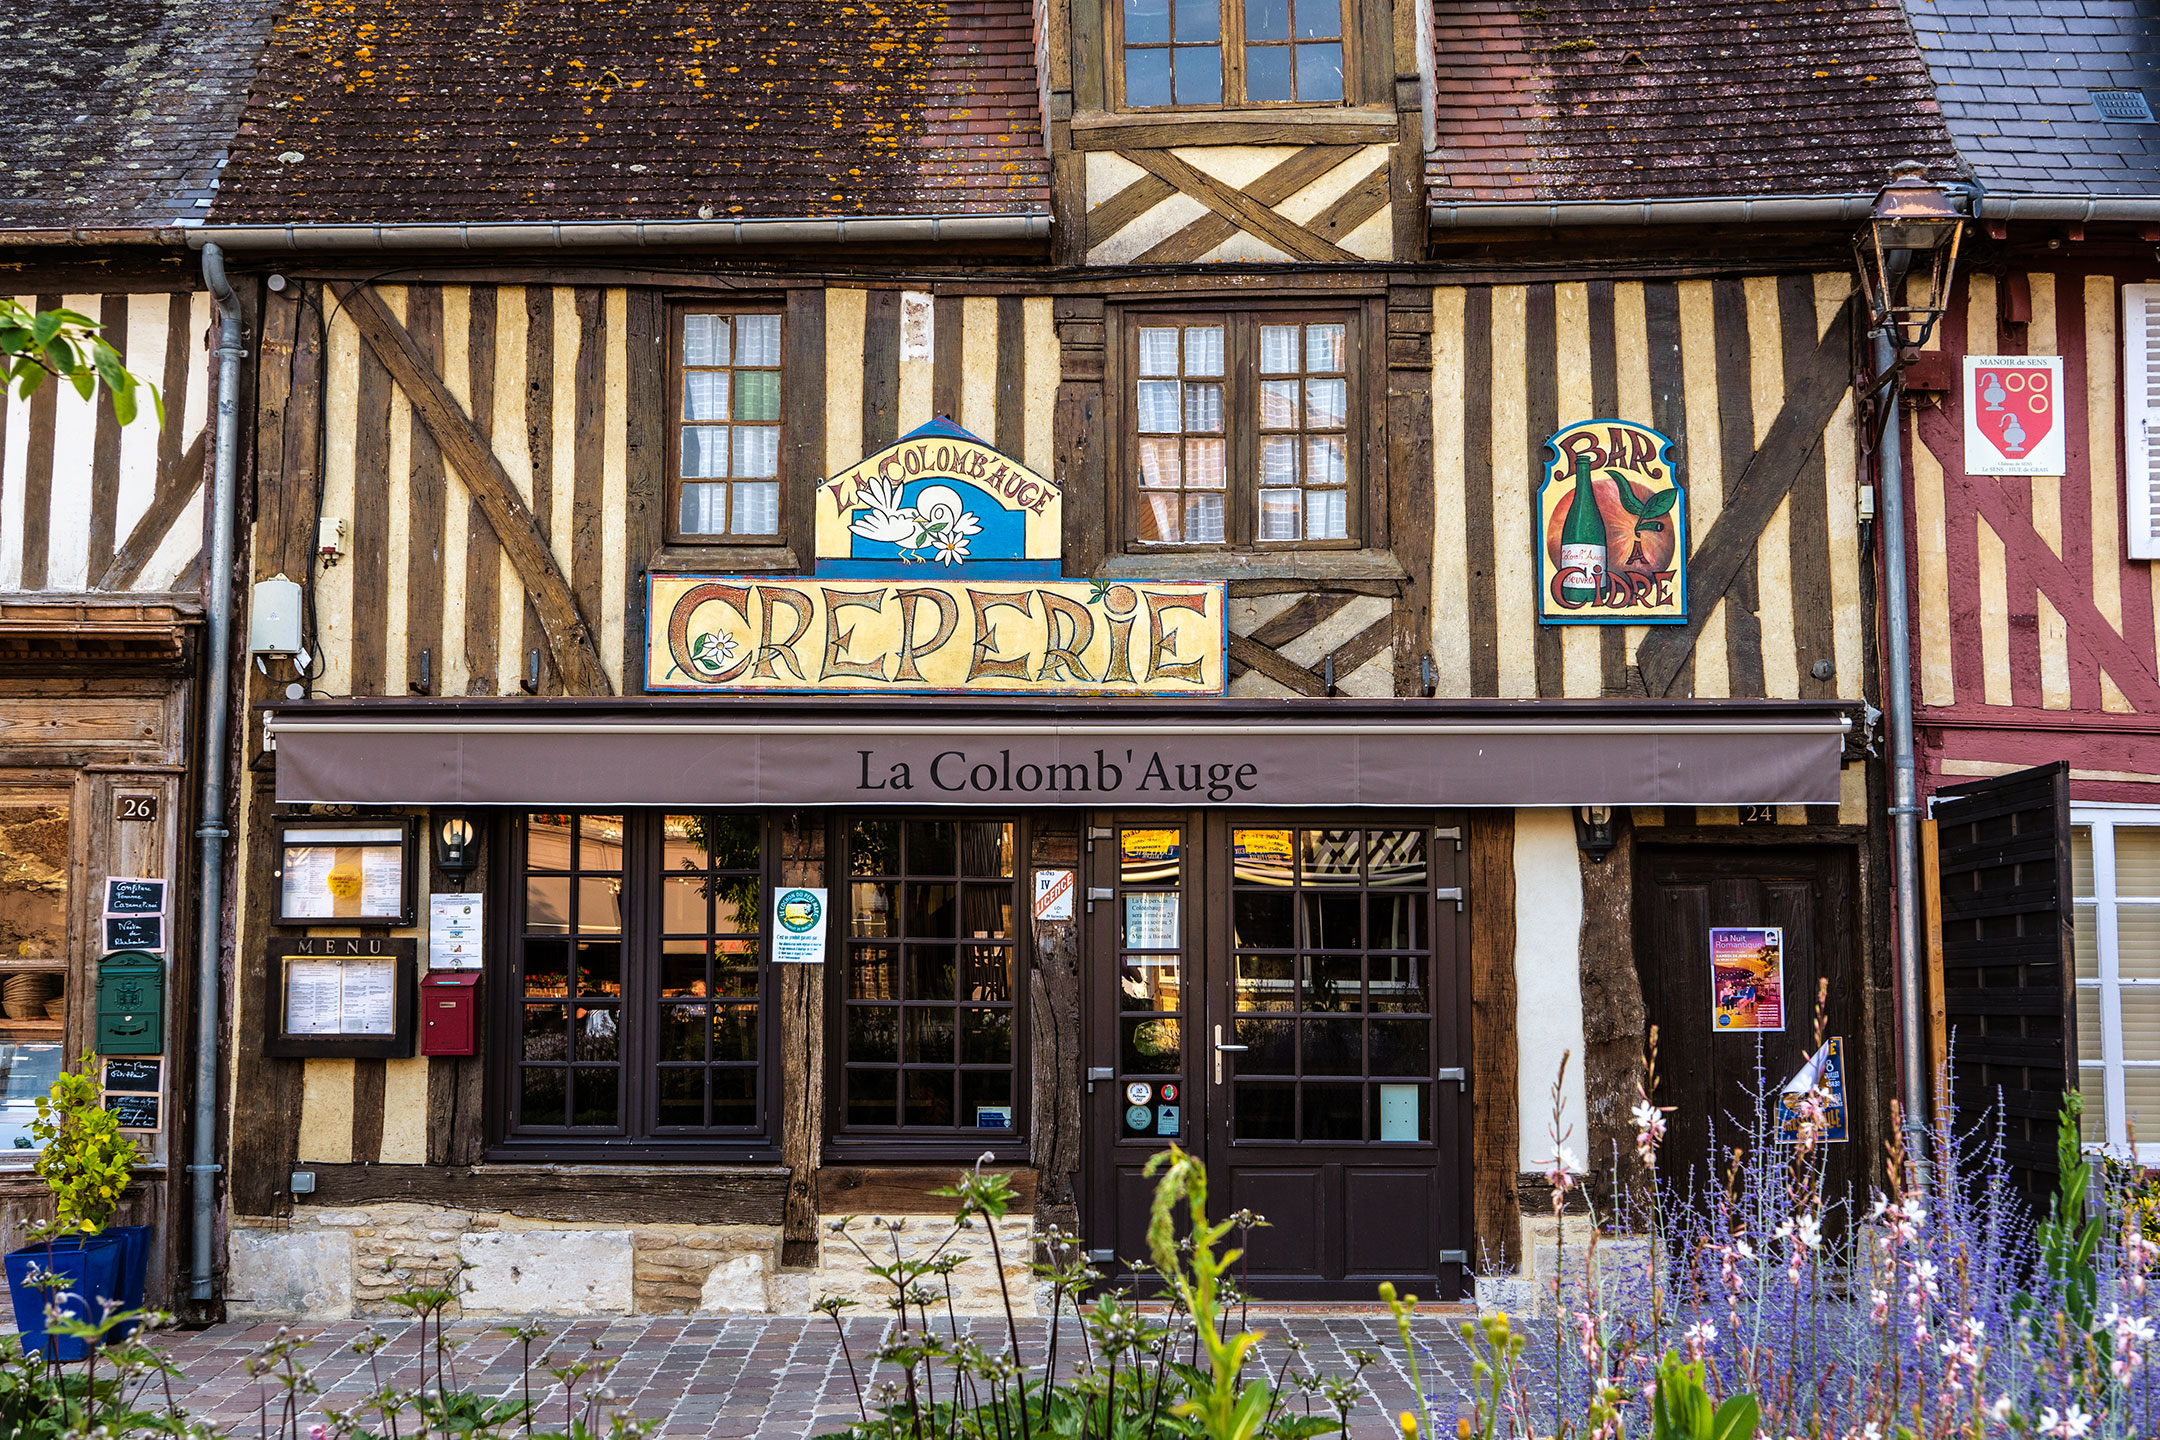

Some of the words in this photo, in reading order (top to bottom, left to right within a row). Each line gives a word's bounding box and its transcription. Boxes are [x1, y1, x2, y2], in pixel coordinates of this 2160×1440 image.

[1979, 358, 2015, 366] MANOIR
[2016, 358, 2026, 366] de
[2027, 358, 2048, 366] SENS
[1554, 427, 1662, 482] BAR
[878, 444, 1056, 518] COLOMB'AUGE
[856, 749, 914, 791] La
[930, 748, 1258, 802] Colomb'Auge
[123, 799, 150, 817] 26
[1746, 805, 1772, 822] 24
[1040, 879, 1051, 890] IV
[1036, 873, 1073, 915] LICENCE
[298, 939, 382, 954] MENU
[1715, 941, 1763, 949] Romantique
[1719, 934, 1729, 942] La
[1730, 934, 1747, 943] Nuit
[1826, 1059, 1834, 1072] 8
